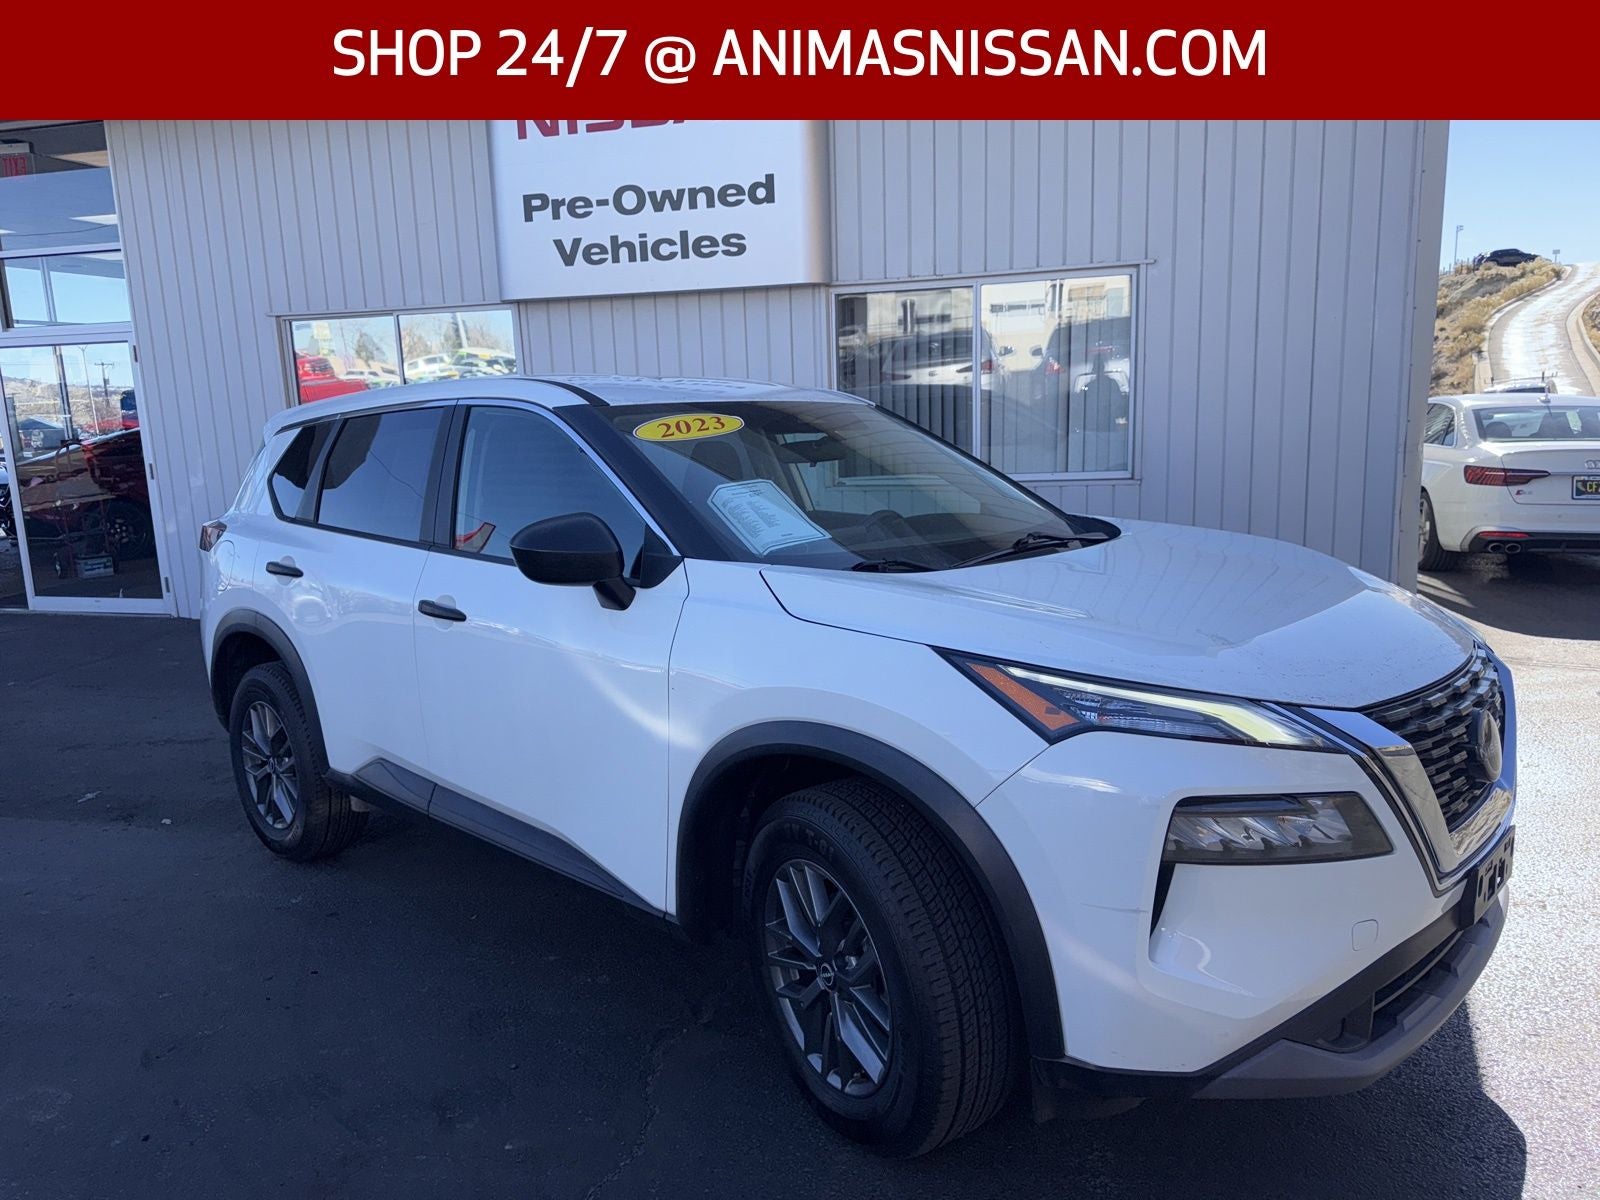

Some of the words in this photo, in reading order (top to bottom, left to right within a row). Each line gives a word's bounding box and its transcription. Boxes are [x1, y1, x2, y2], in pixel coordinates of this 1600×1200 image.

[522, 173, 776, 223] Pre-Owned
[552, 230, 747, 267] Vehicles
[657, 416, 726, 438] 2023
